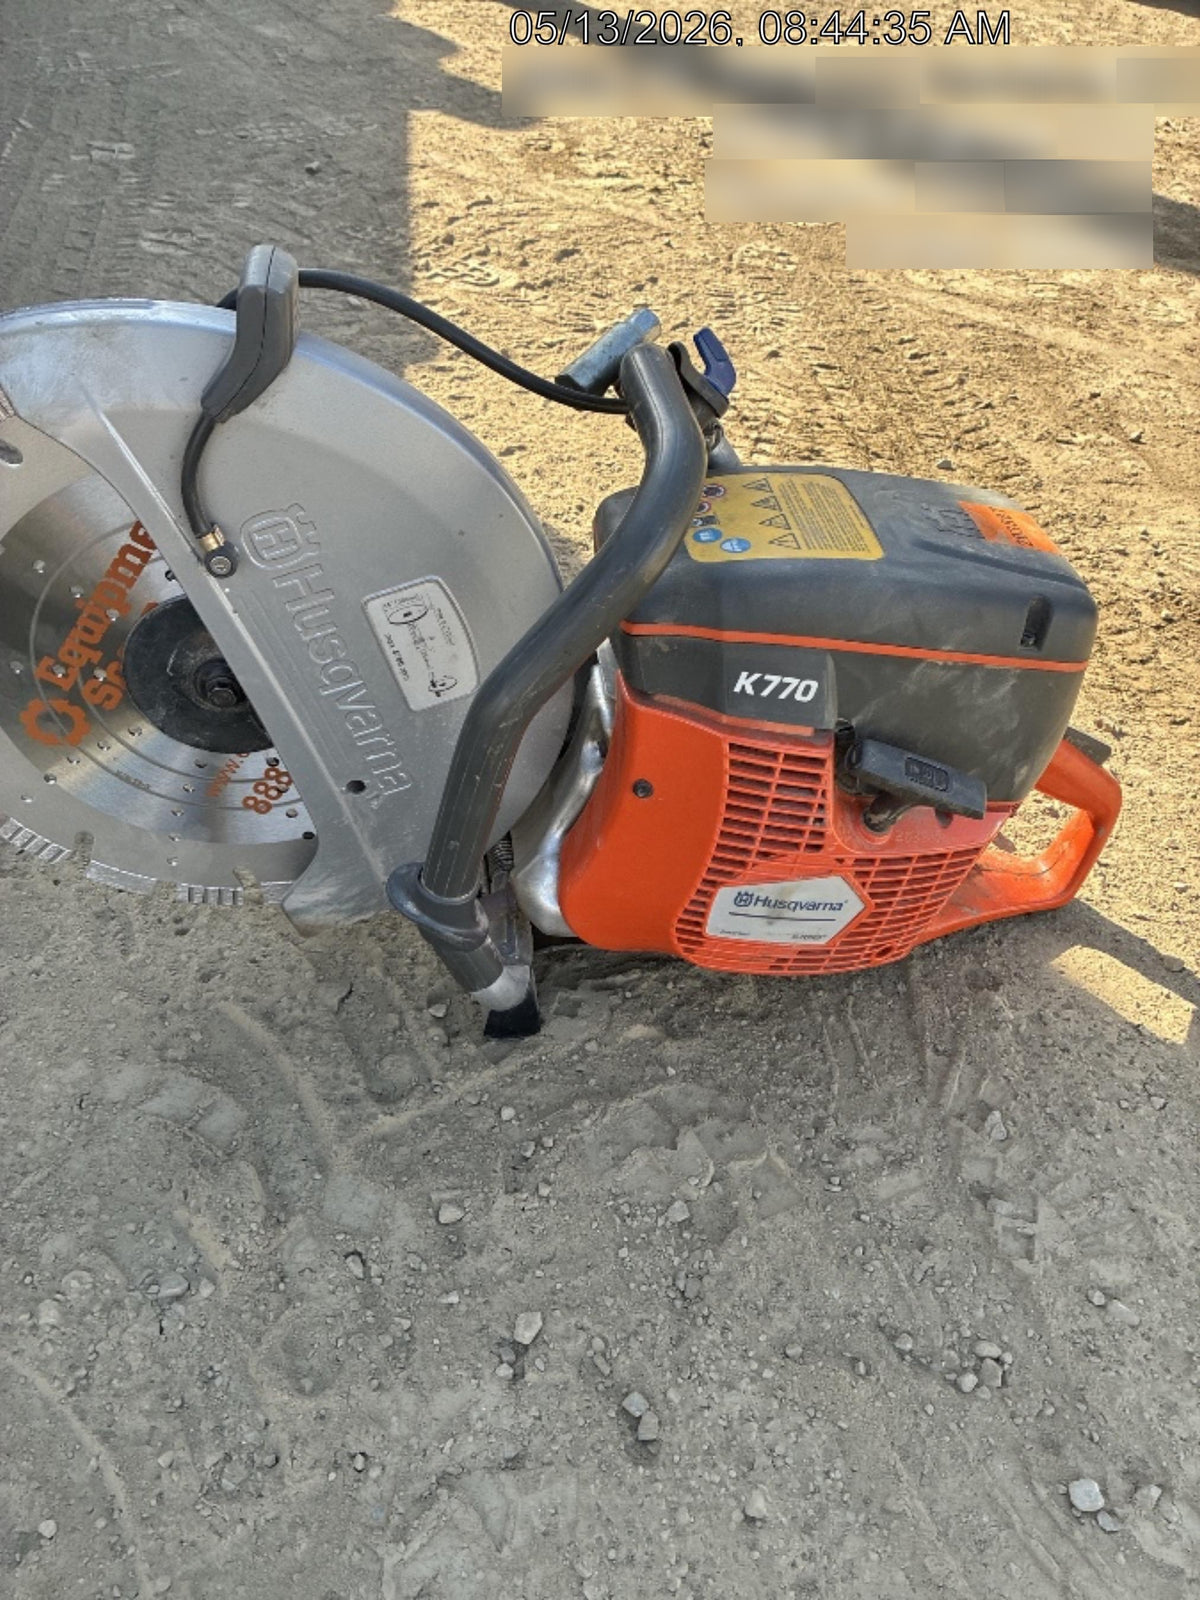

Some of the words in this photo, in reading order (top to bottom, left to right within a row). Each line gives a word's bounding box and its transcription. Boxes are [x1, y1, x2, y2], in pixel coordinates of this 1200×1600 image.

[272, 562, 414, 798] Husqvarna
[733, 671, 819, 703] K770
[753, 895, 844, 912] Husqvarna
